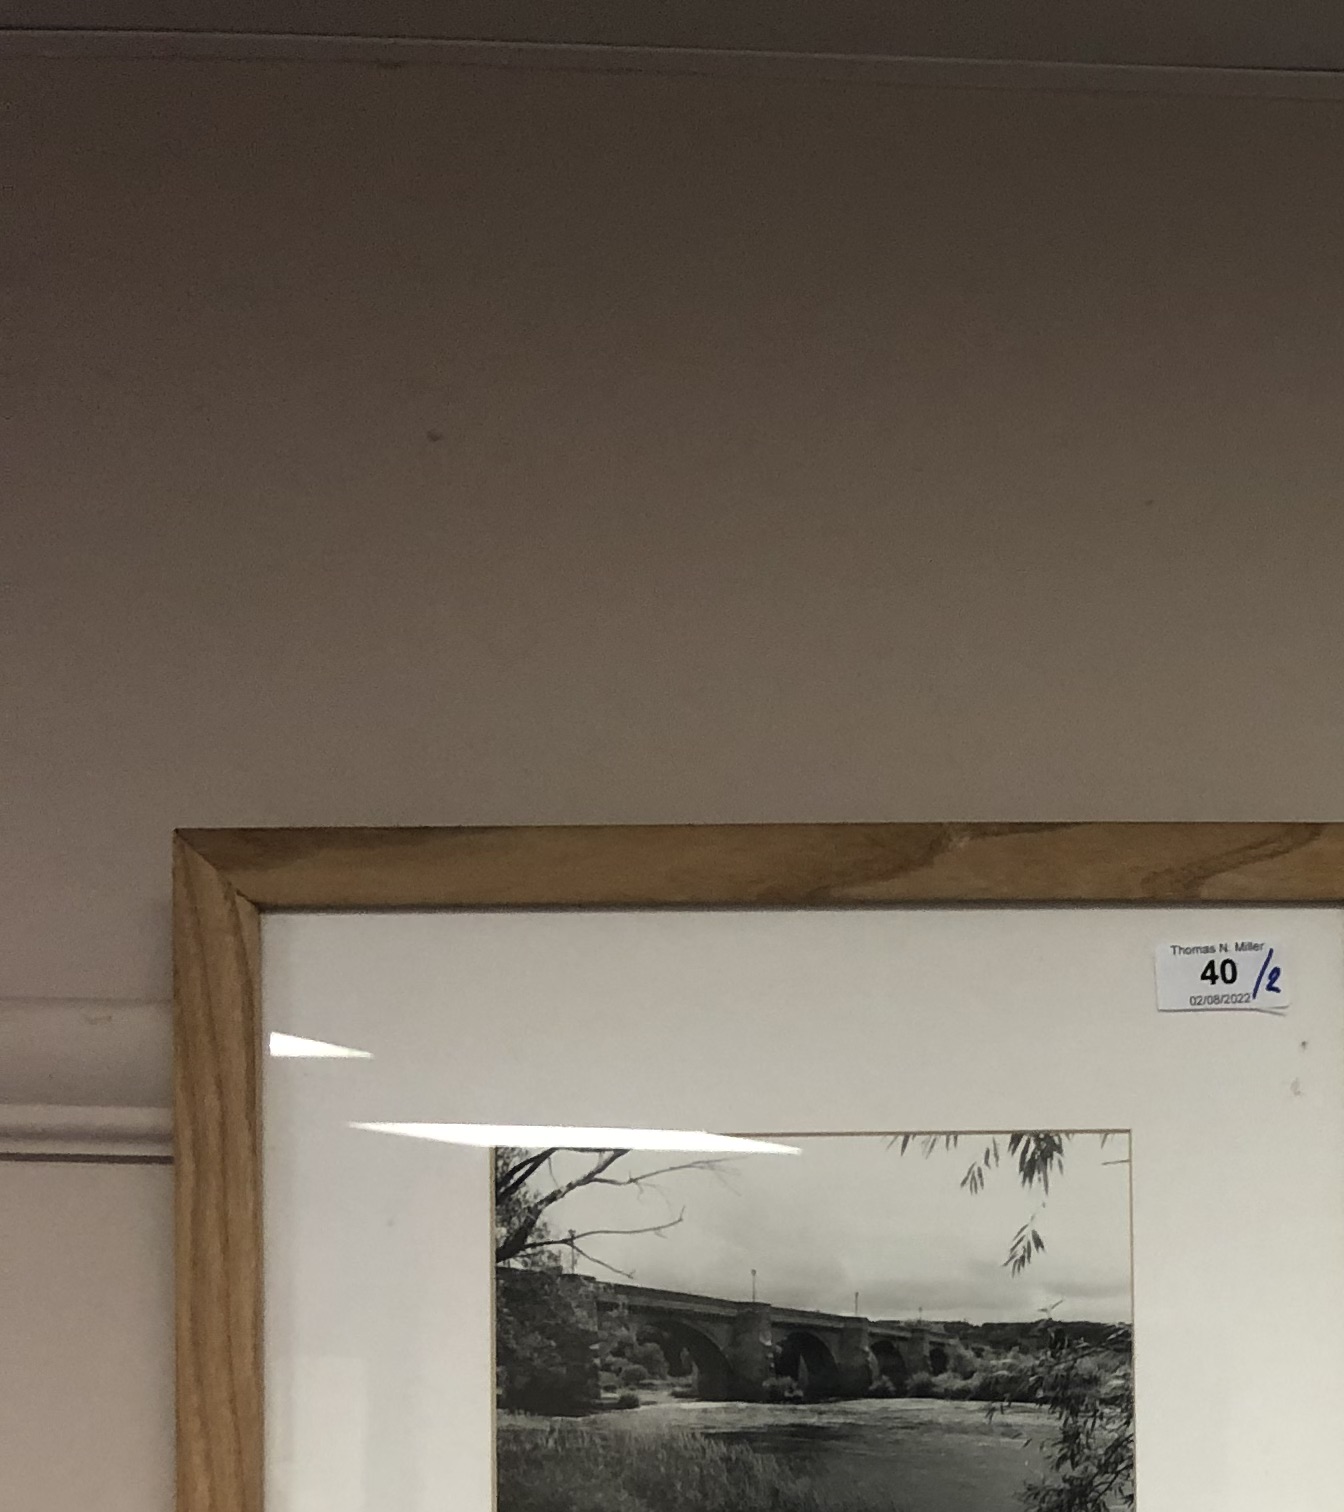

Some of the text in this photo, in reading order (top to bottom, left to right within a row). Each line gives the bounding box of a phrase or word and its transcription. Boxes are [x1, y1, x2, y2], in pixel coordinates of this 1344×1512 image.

[1170, 944, 1216, 956] Thomas
[1235, 941, 1265, 952] Miller
[1200, 957, 1238, 985] 40
[1189, 993, 1251, 1006] 02/08/2022
